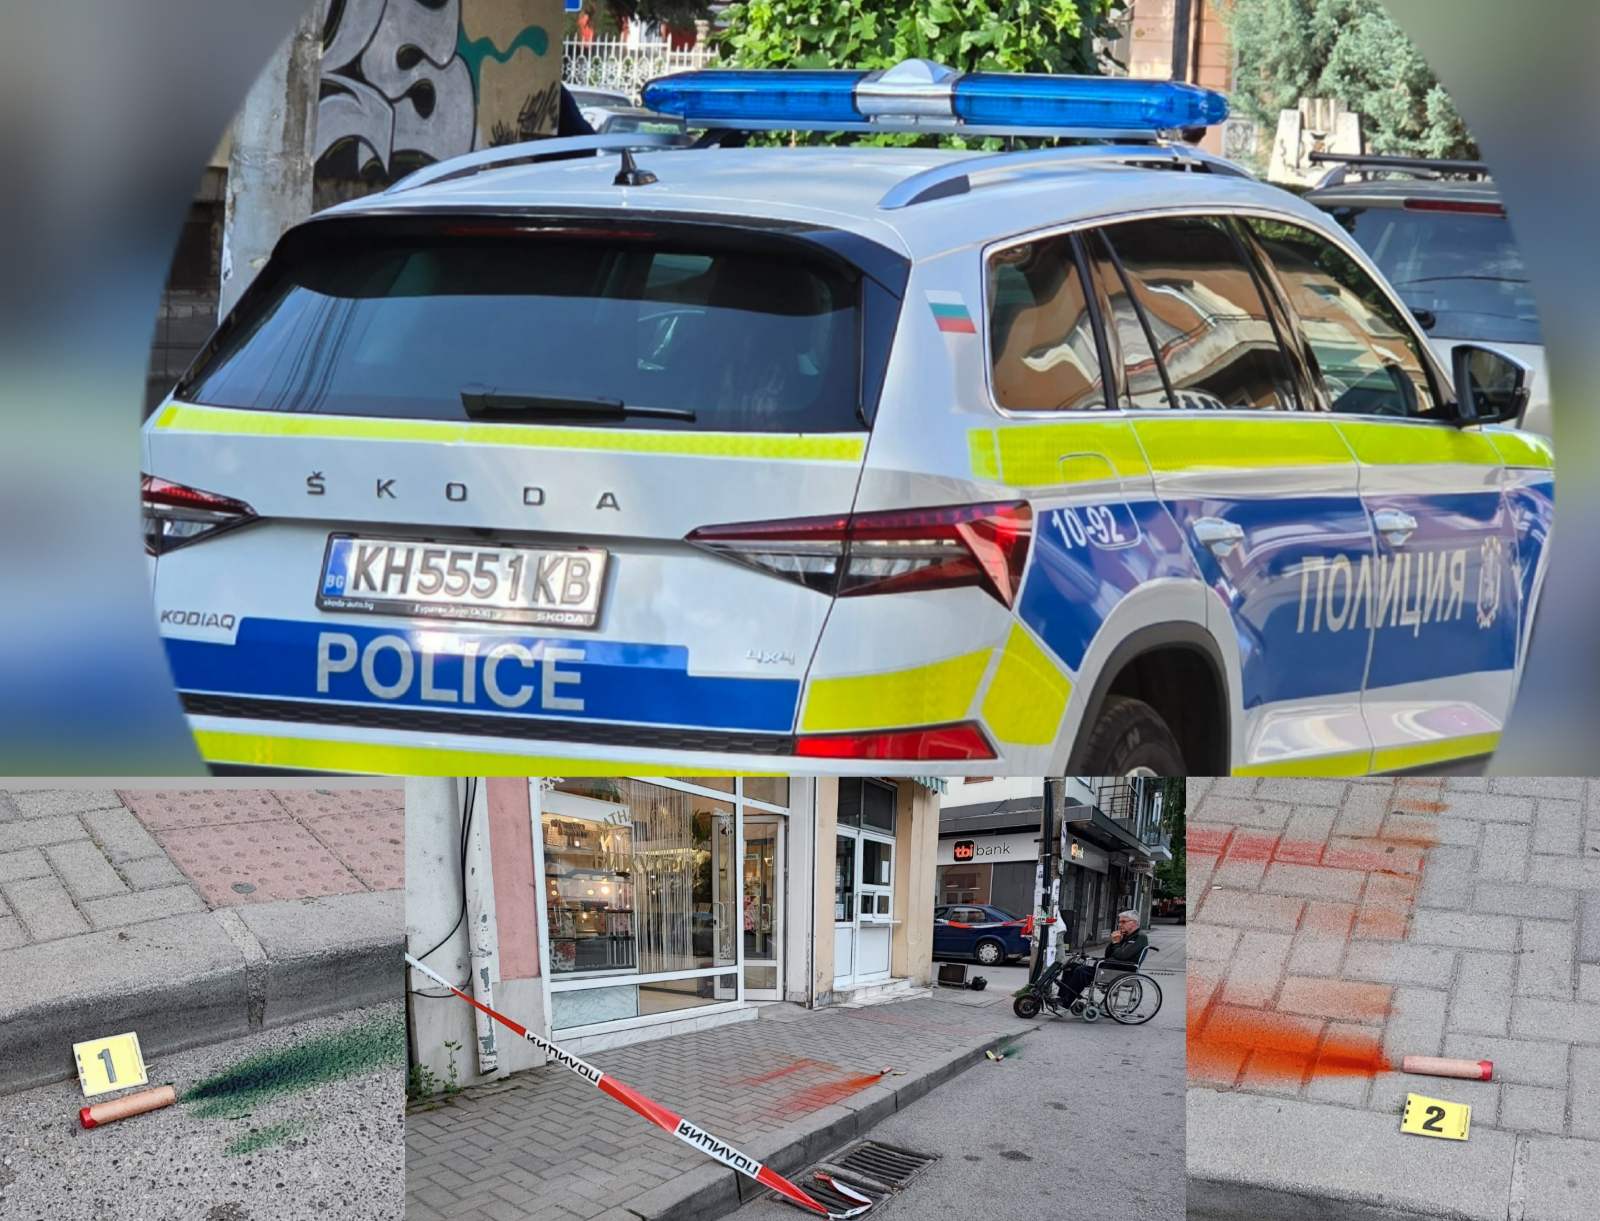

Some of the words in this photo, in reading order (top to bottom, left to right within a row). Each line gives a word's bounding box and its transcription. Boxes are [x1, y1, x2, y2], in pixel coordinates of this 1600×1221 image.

[1051, 506, 1125, 549] 10-92
[326, 574, 344, 588] BG
[1296, 550, 1467, 638] ПОЛИЦИЯ
[160, 609, 236, 631] KODIAQ
[316, 631, 586, 711] POLICE
[955, 843, 974, 858] tbi
[976, 842, 1010, 855] bank
[97, 1048, 117, 1083] 1
[1423, 1105, 1446, 1132] 2
[678, 1122, 759, 1175] ПОЛИЦИЯ
